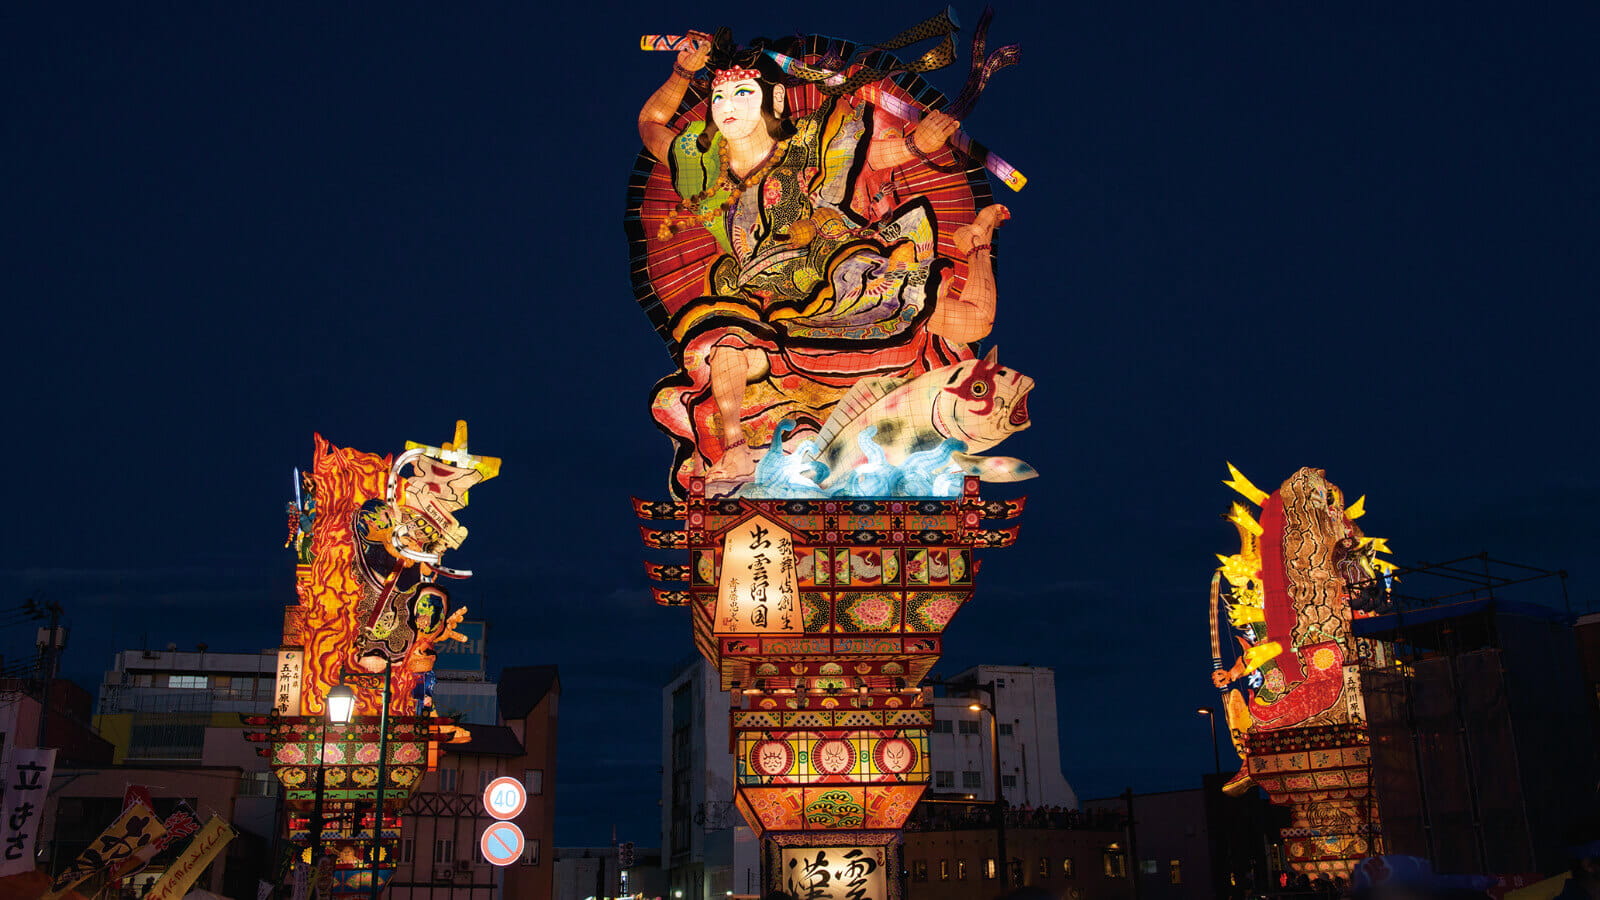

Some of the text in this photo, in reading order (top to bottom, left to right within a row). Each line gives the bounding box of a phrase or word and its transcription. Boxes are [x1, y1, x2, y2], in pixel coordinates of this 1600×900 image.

[747, 523, 772, 629] 出雲阿国
[278, 663, 292, 713] 五所川原市
[494, 790, 517, 808] 40
